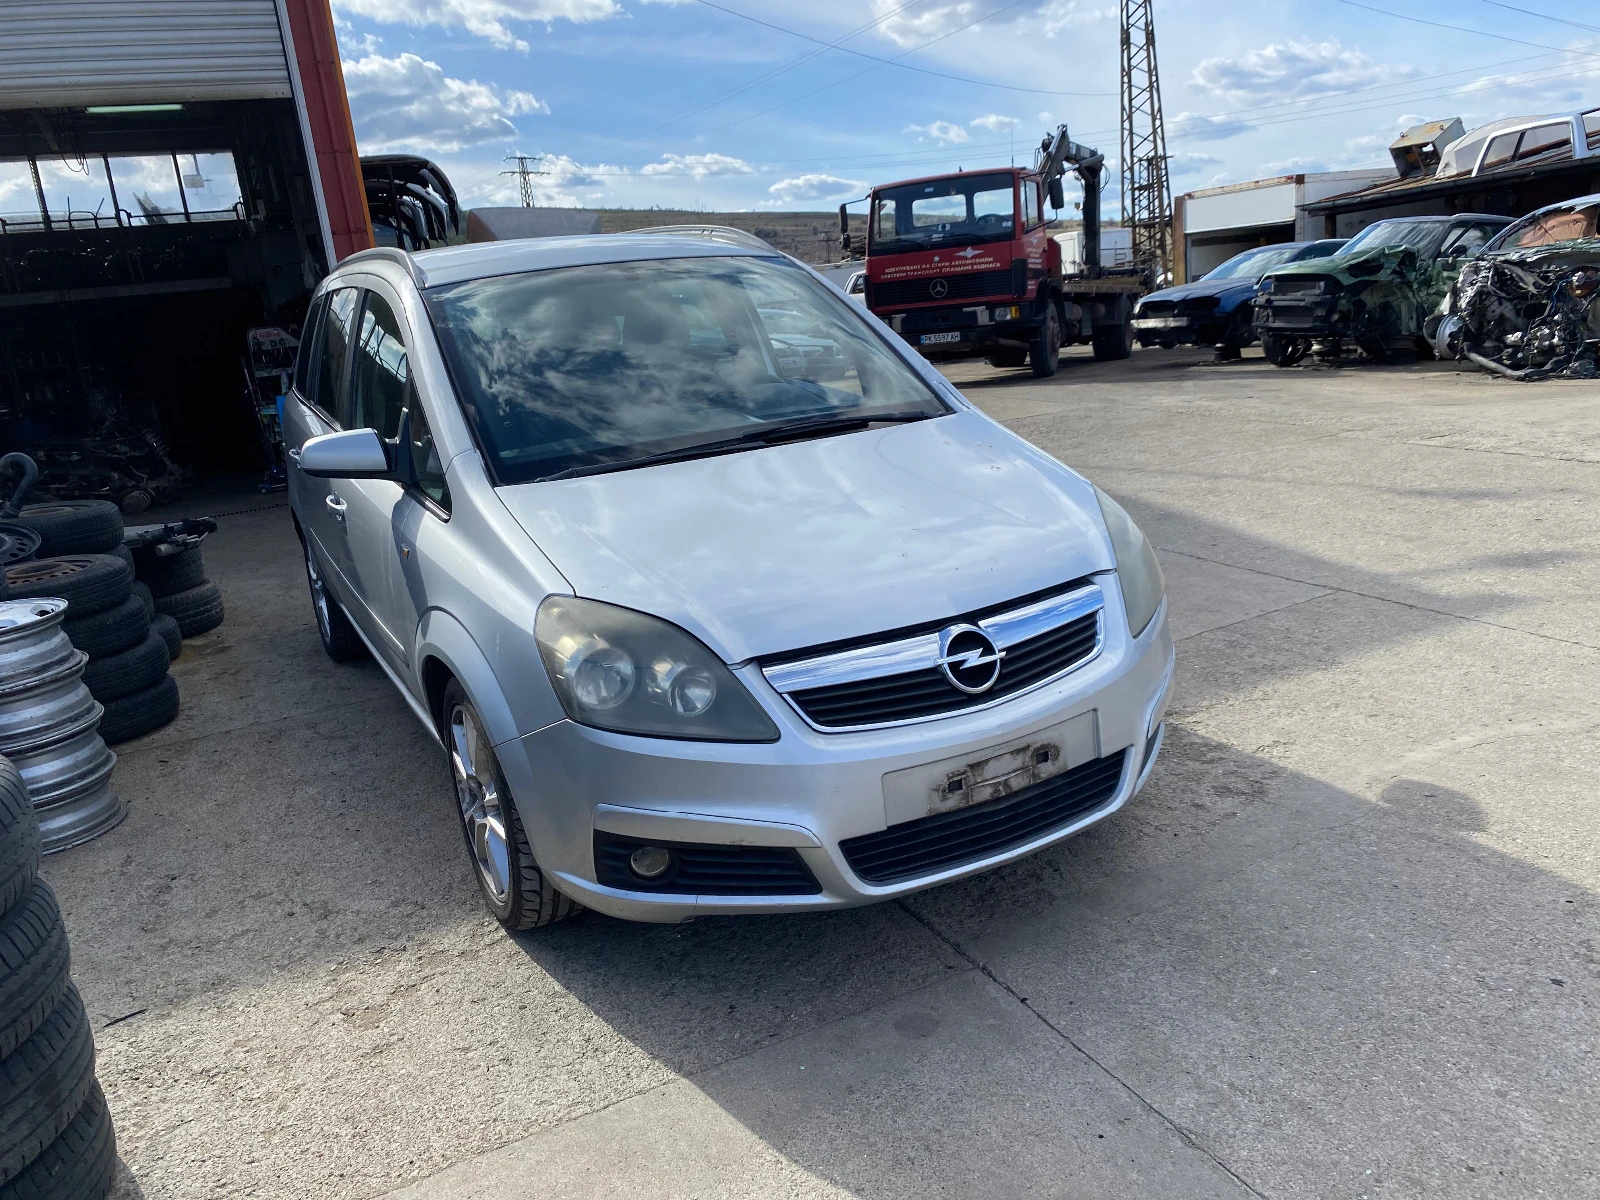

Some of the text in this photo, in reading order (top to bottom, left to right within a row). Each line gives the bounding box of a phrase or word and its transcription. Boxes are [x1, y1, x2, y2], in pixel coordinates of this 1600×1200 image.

[951, 257, 994, 266] АВТОМОБИЛИ
[907, 268, 940, 276] ТРАНСПОРТ
[924, 332, 959, 343] PK 5597 AH
